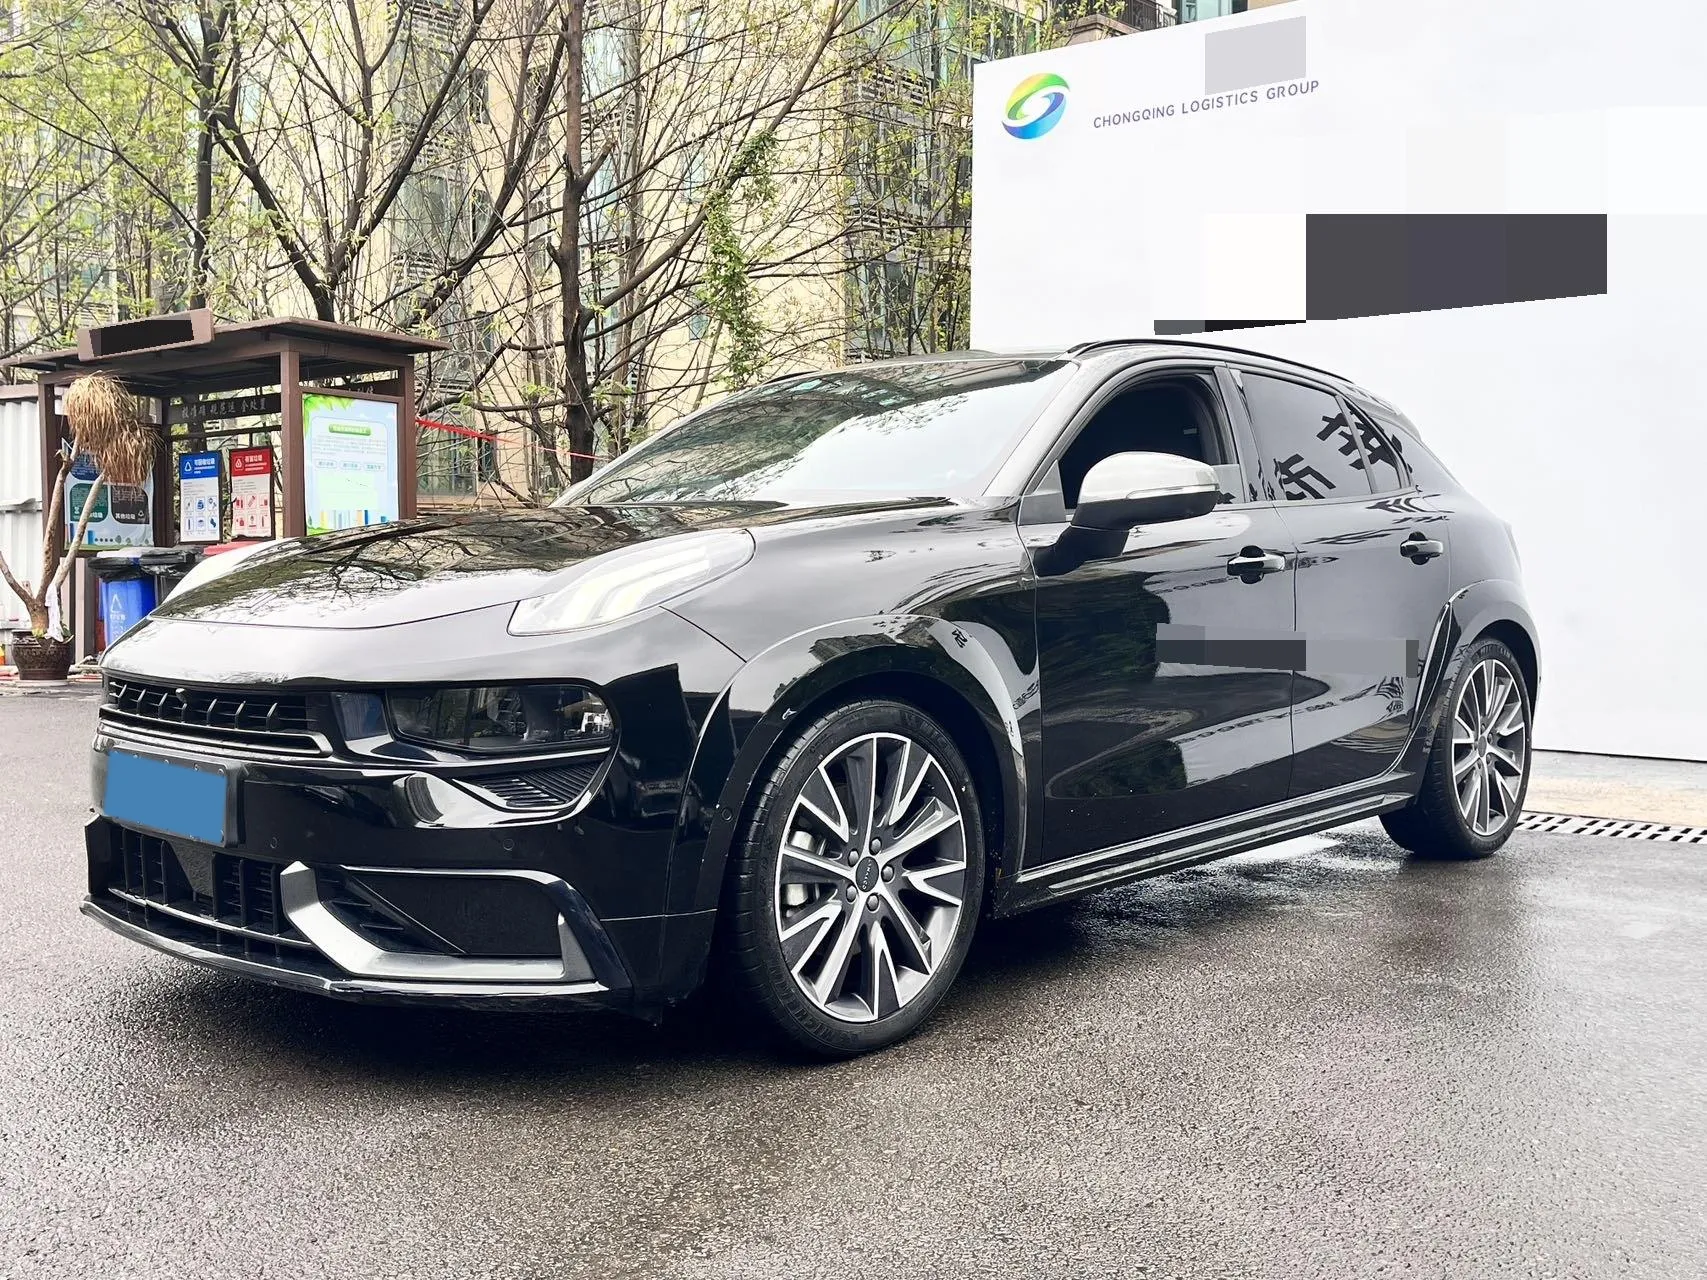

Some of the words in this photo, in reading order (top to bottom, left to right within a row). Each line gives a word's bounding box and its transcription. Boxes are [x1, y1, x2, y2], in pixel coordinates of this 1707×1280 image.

[1093, 104, 1175, 129] CHONGQING
[1181, 90, 1258, 115] LOGISTICS
[1266, 80, 1319, 100] GROUP
